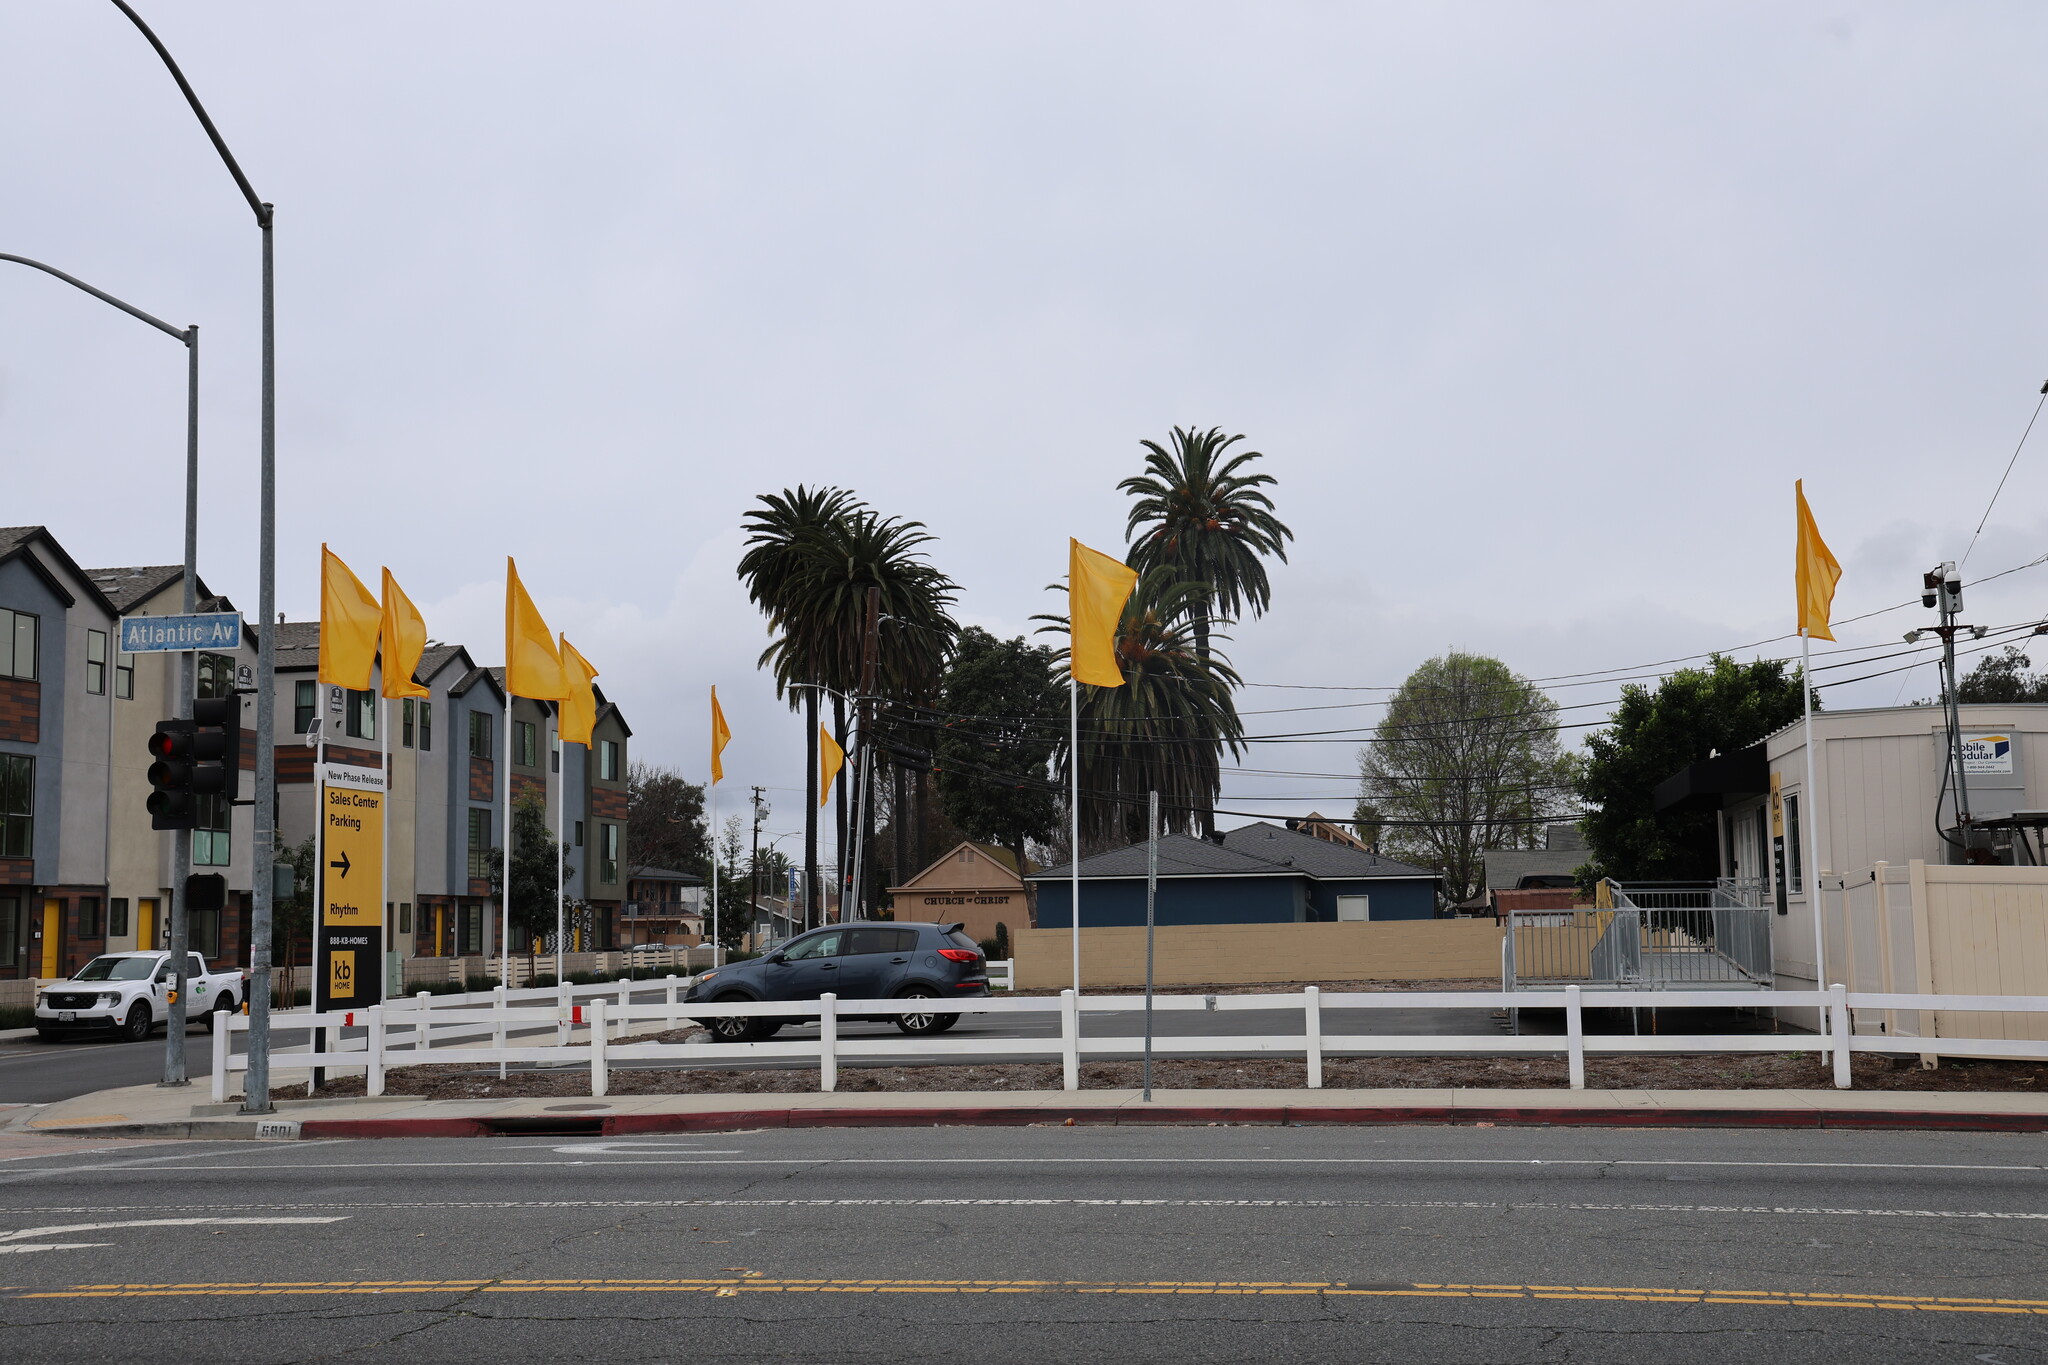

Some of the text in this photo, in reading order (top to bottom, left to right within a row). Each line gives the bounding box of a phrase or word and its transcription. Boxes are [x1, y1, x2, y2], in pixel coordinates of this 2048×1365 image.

[128, 622, 233, 644] Atlantic Av
[328, 770, 384, 786] New Phase Release
[330, 792, 379, 809] Sales Center
[330, 813, 361, 832] Parking
[924, 897, 965, 906] CHURCH
[973, 896, 1010, 905] CHRIST
[330, 903, 359, 919] Rhythm
[329, 936, 368, 945] 888-KB-HOMES
[334, 960, 351, 980] kb
[334, 982, 350, 990] HOME
